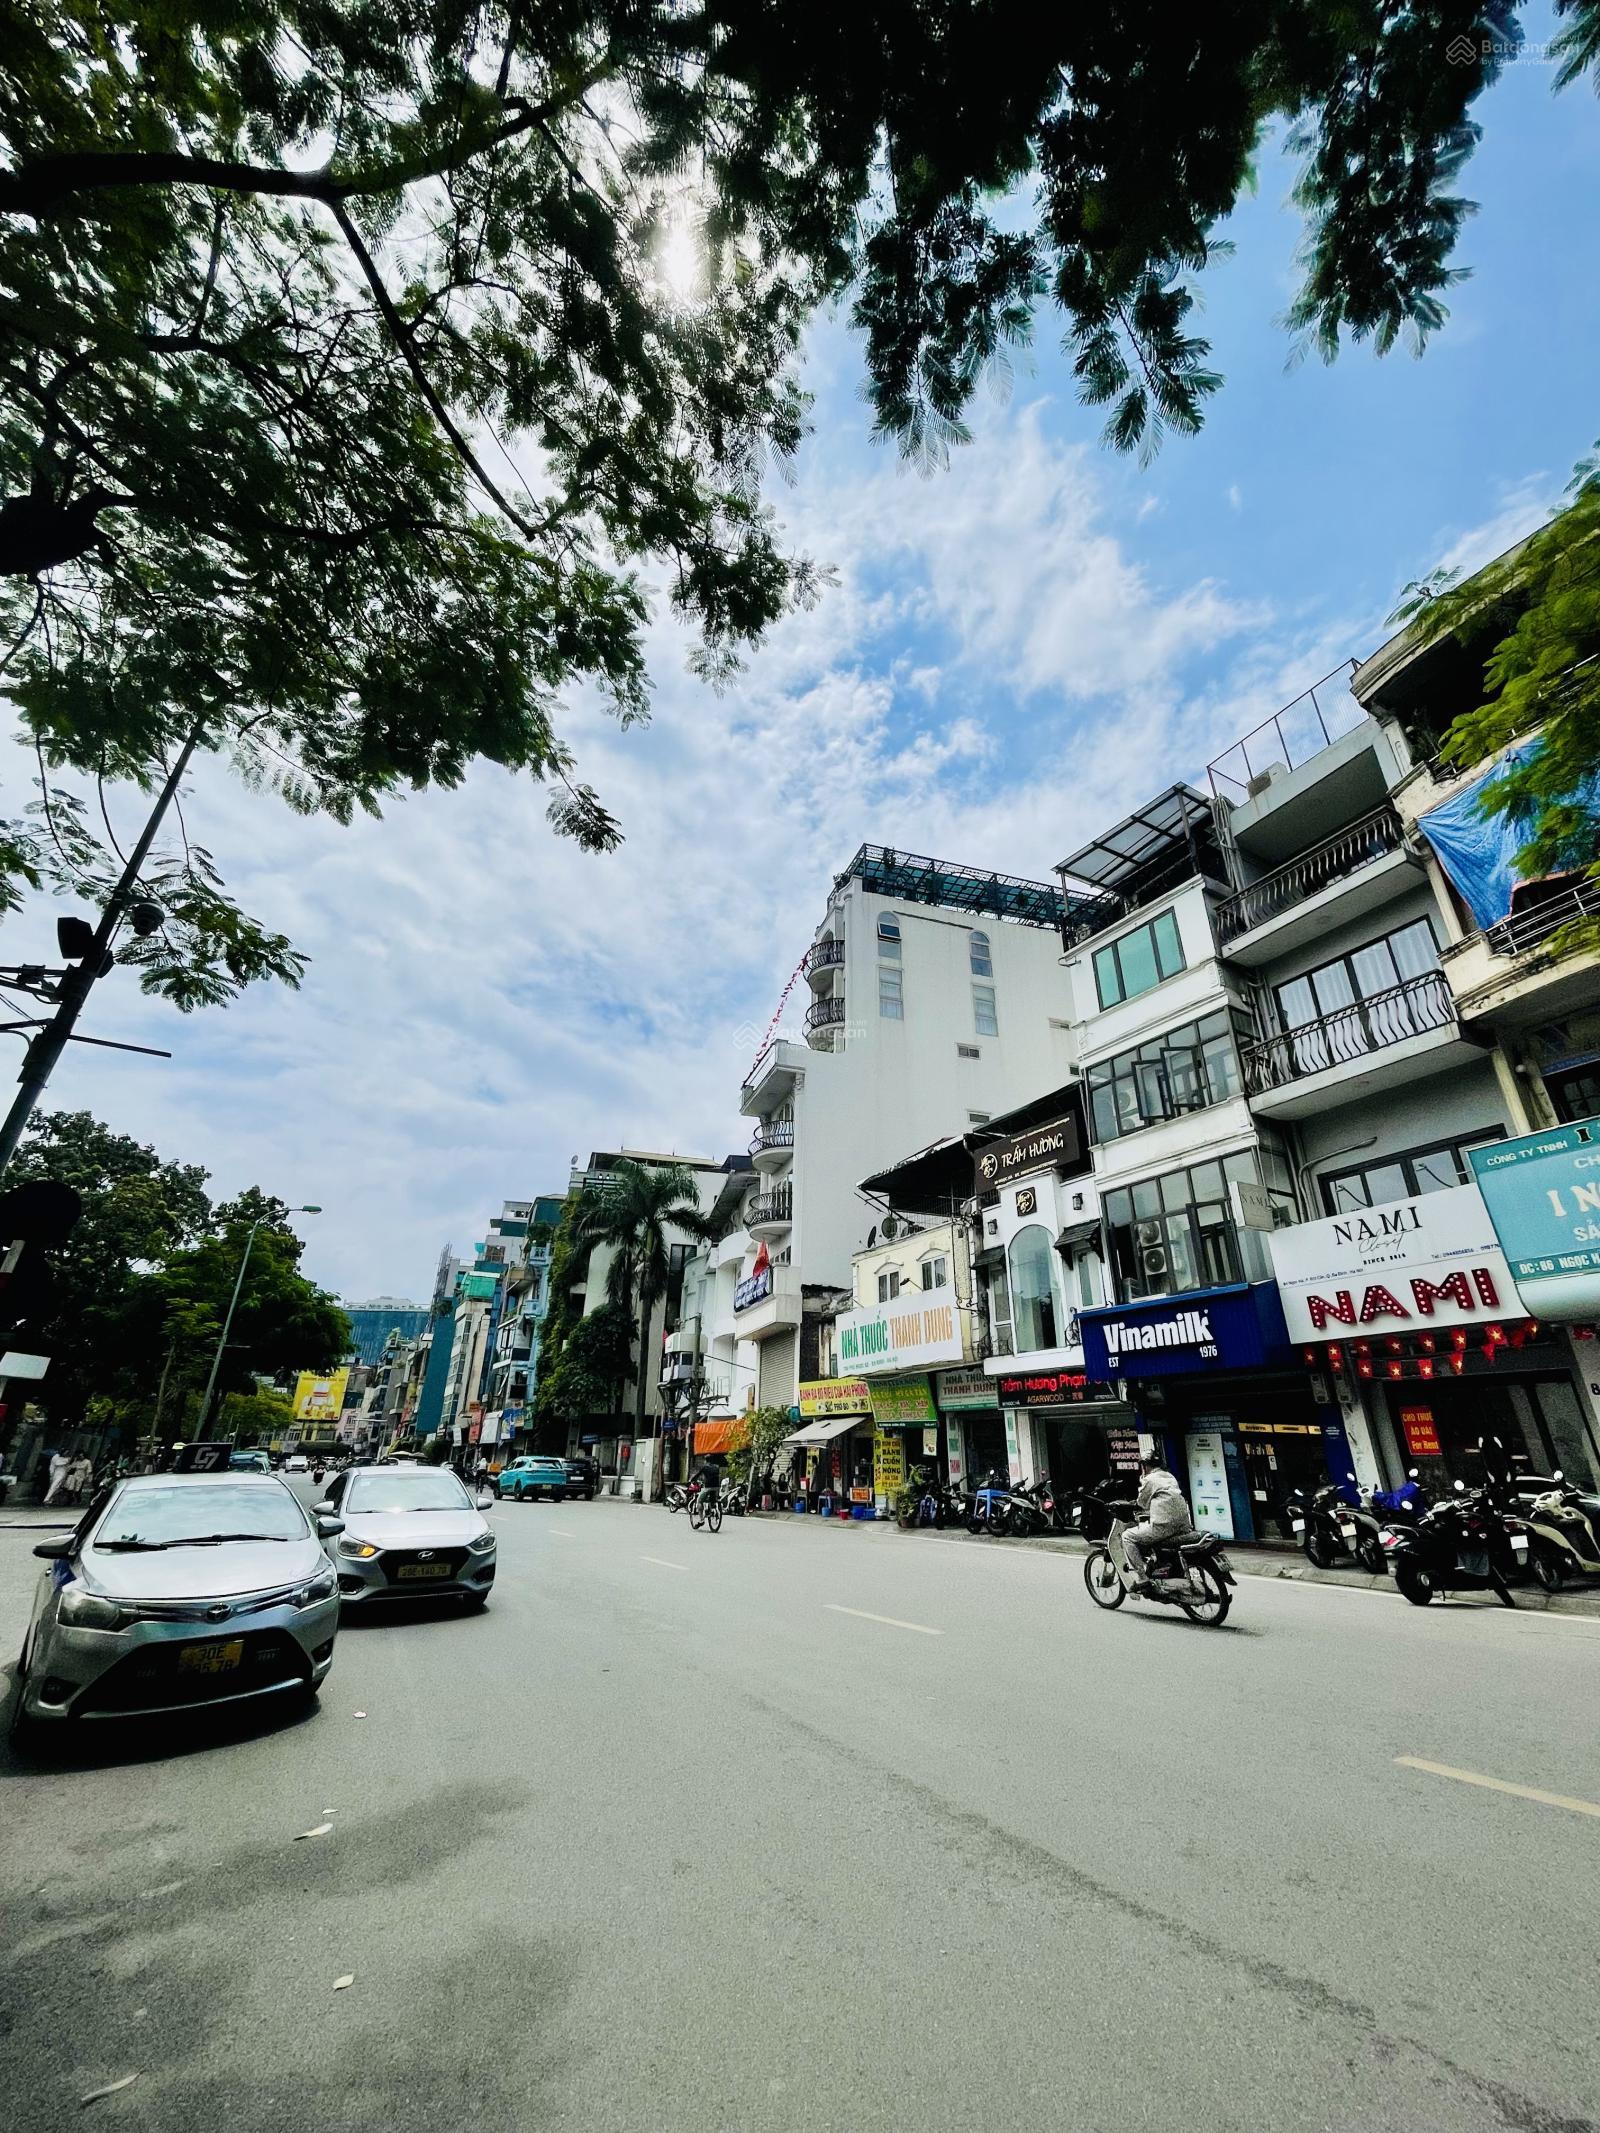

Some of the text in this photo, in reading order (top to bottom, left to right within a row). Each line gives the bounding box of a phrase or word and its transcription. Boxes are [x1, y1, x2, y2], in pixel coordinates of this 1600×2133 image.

[1486, 1152, 1517, 1166] CÔNG
[1519, 1148, 1534, 1158] TY
[1536, 1140, 1569, 1154] TNHH
[1332, 1206, 1423, 1245] NAMI
[1306, 1268, 1500, 1328] NAMI
[841, 1305, 953, 1360] NHÀ THUỐC THANH DUNG
[1103, 1312, 1214, 1354] Vinamilk
[1108, 1345, 1218, 1367] EST 1976
[943, 1385, 971, 1395] THANH
[1027, 1394, 1065, 1404] AGARWOOD
[1402, 1413, 1416, 1422] CHO
[1411, 1440, 1422, 1450] For
